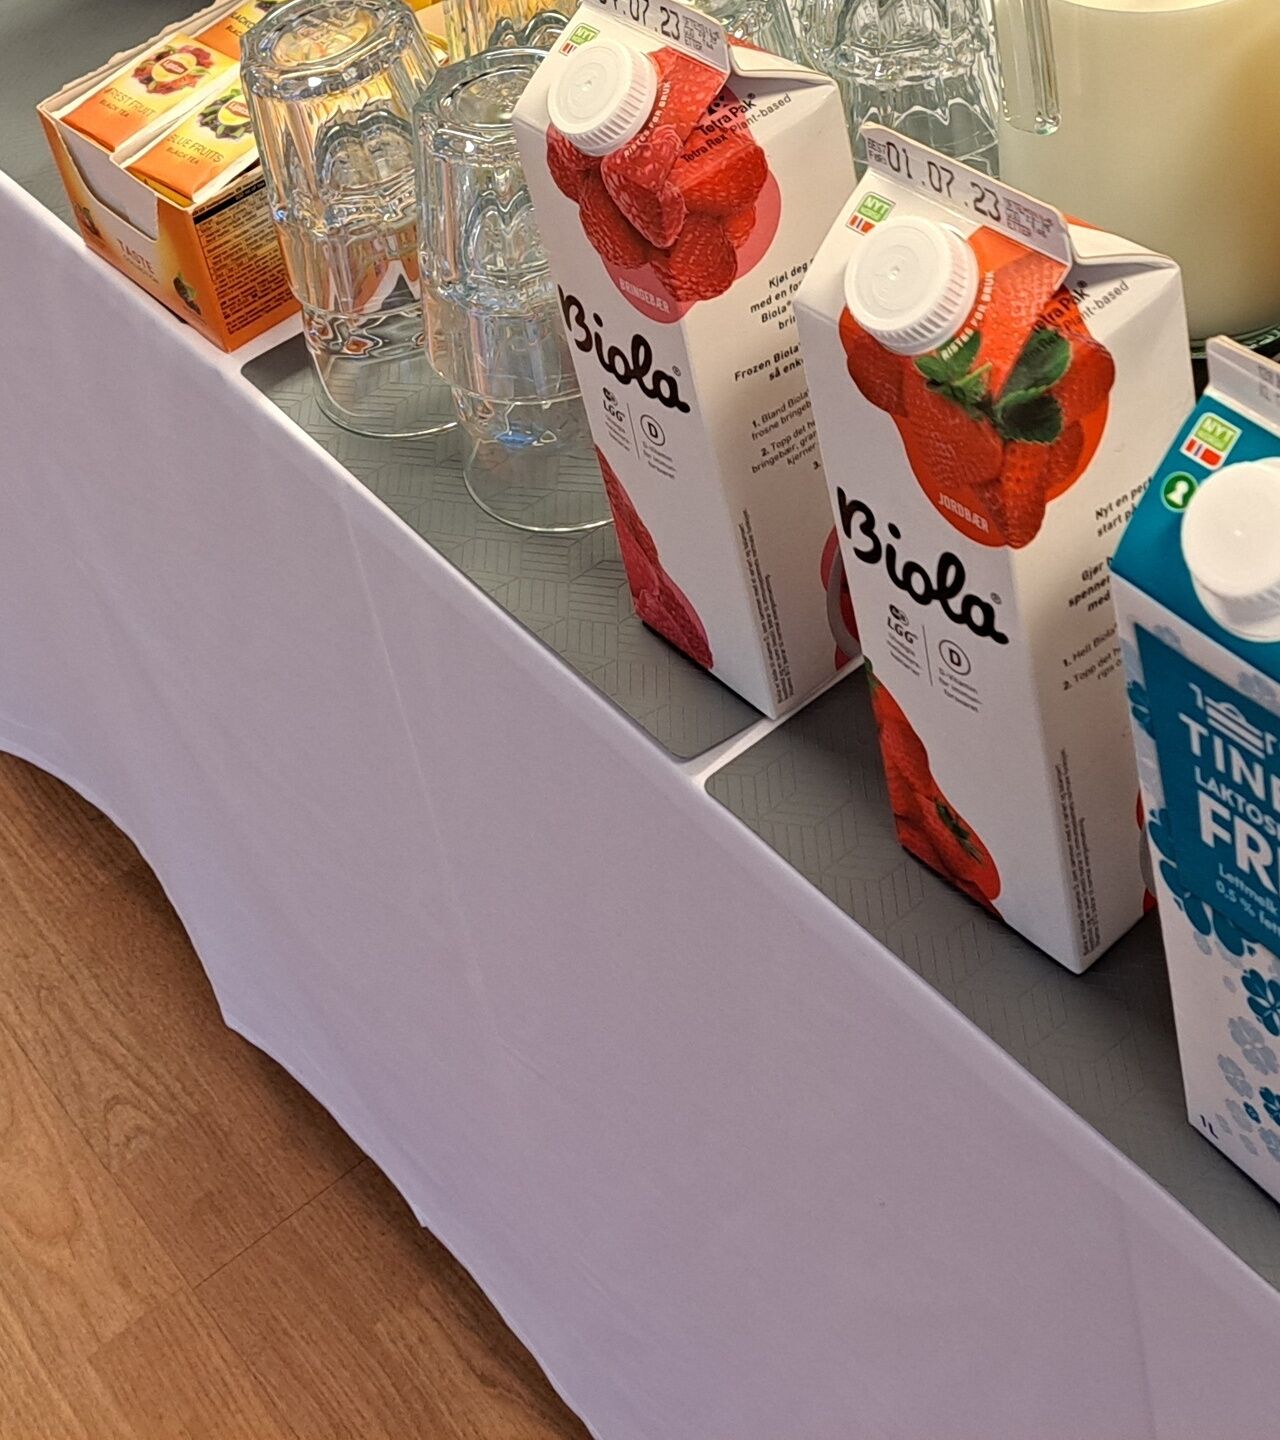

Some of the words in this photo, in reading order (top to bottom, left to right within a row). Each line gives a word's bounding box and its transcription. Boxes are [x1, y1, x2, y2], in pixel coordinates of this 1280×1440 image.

[681, 141, 708, 163] Tetra
[730, 93, 792, 135] Plant-based
[694, 112, 732, 136] Tetra
[790, 262, 808, 278] deg
[750, 295, 772, 313] med
[774, 289, 787, 301] en
[734, 360, 771, 382] Frozen
[761, 404, 786, 423] Bland
[751, 422, 780, 441] frosne
[770, 434, 792, 451] Topp
[793, 425, 807, 438] det
[1115, 494, 1128, 507] en
[938, 492, 990, 534] JORDBÆR
[1097, 514, 1123, 537] start
[887, 616, 919, 645] LGG
[1218, 861, 1279, 916] Lettmelk
